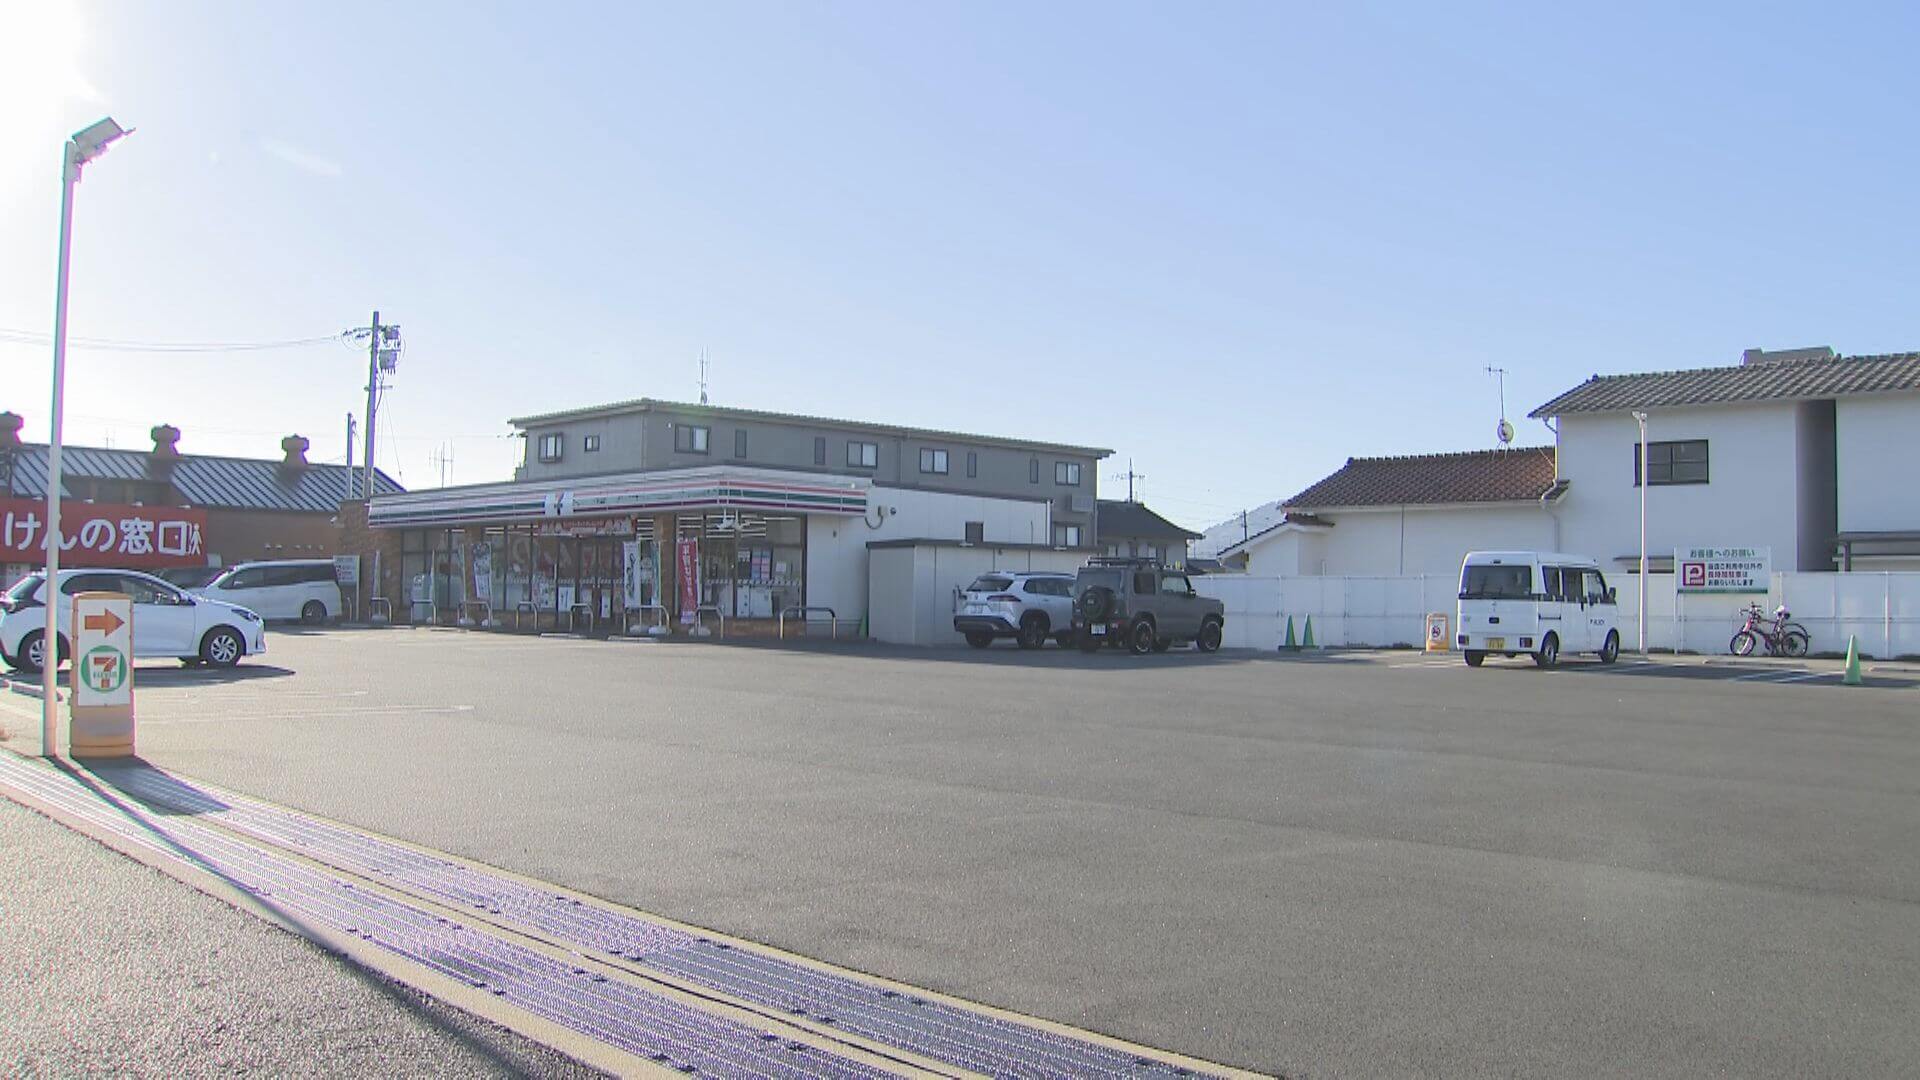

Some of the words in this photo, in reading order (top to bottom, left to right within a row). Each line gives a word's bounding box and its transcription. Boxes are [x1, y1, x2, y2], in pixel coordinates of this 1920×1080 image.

[1690, 549, 1755, 558] お客様へのお願い
